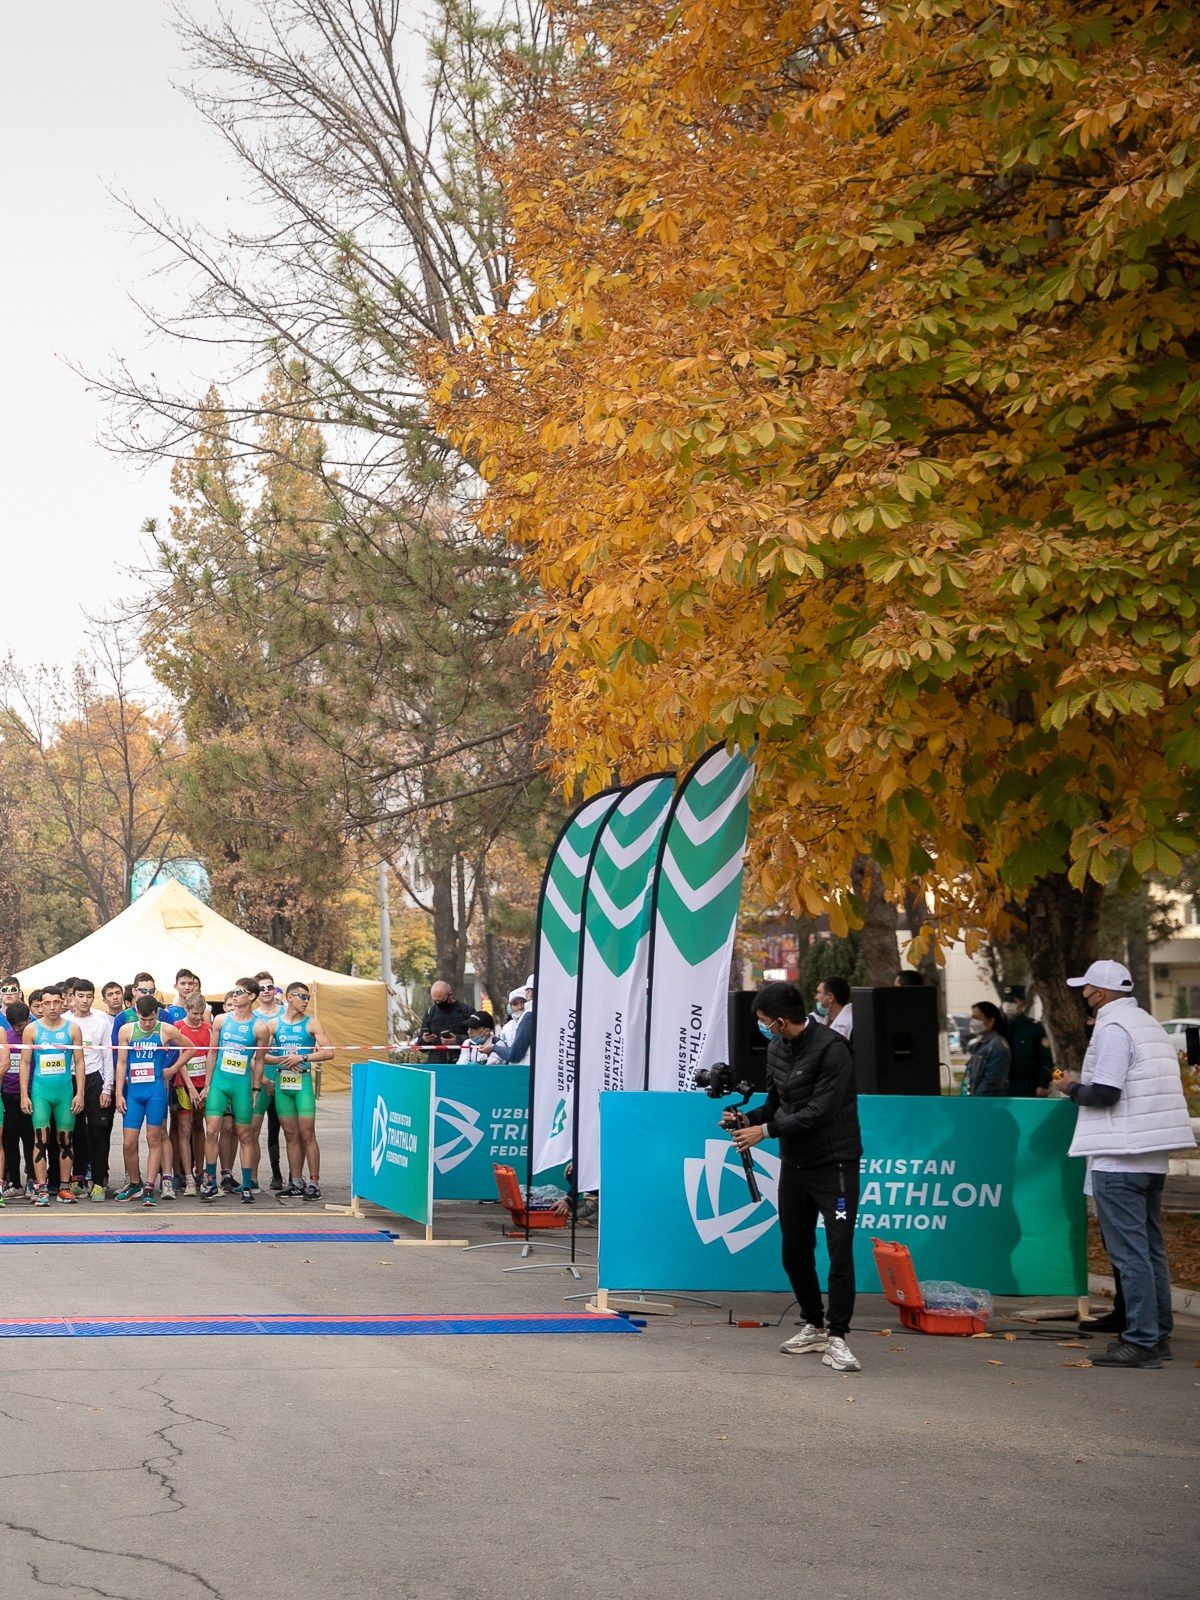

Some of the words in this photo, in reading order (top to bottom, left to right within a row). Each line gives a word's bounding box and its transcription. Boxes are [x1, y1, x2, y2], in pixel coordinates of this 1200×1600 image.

[45, 1060, 61, 1068] 028
[226, 1059, 242, 1067] 029
[557, 1027, 566, 1092] UZBEKISTAN
[389, 1111, 412, 1128] UZBEKISTAN
[387, 1127, 418, 1154] TRIATHLON
[490, 1123, 527, 1141] TRI
[385, 1150, 409, 1168] FEDERATION
